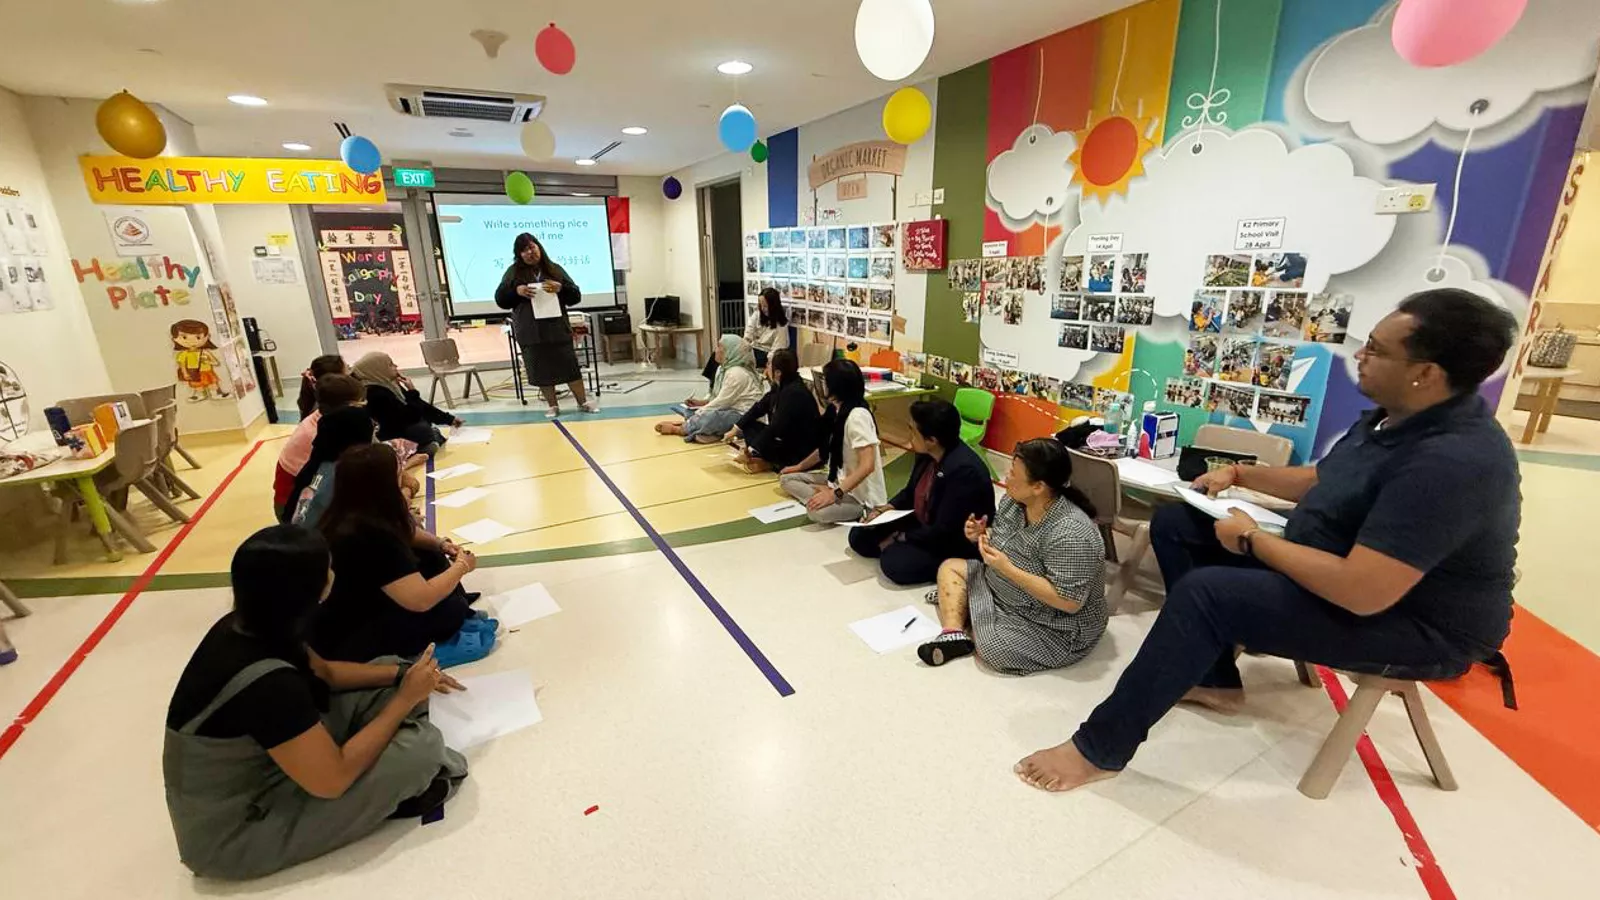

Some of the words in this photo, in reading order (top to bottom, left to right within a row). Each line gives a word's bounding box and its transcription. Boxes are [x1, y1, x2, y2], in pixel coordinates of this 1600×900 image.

[856, 147, 888, 168] MARKET
[92, 167, 245, 193] HEALTHY
[266, 168, 382, 194] EATING
[402, 172, 426, 185] EXIT
[483, 219, 510, 229] Write
[512, 219, 566, 230] something
[567, 219, 589, 229] nice
[1253, 220, 1280, 229] Primary
[1240, 231, 1264, 239] School
[71, 256, 201, 288] Healthy
[1512, 164, 1584, 379] SPARK
[106, 285, 192, 310] Plate
[354, 291, 382, 304] Day
